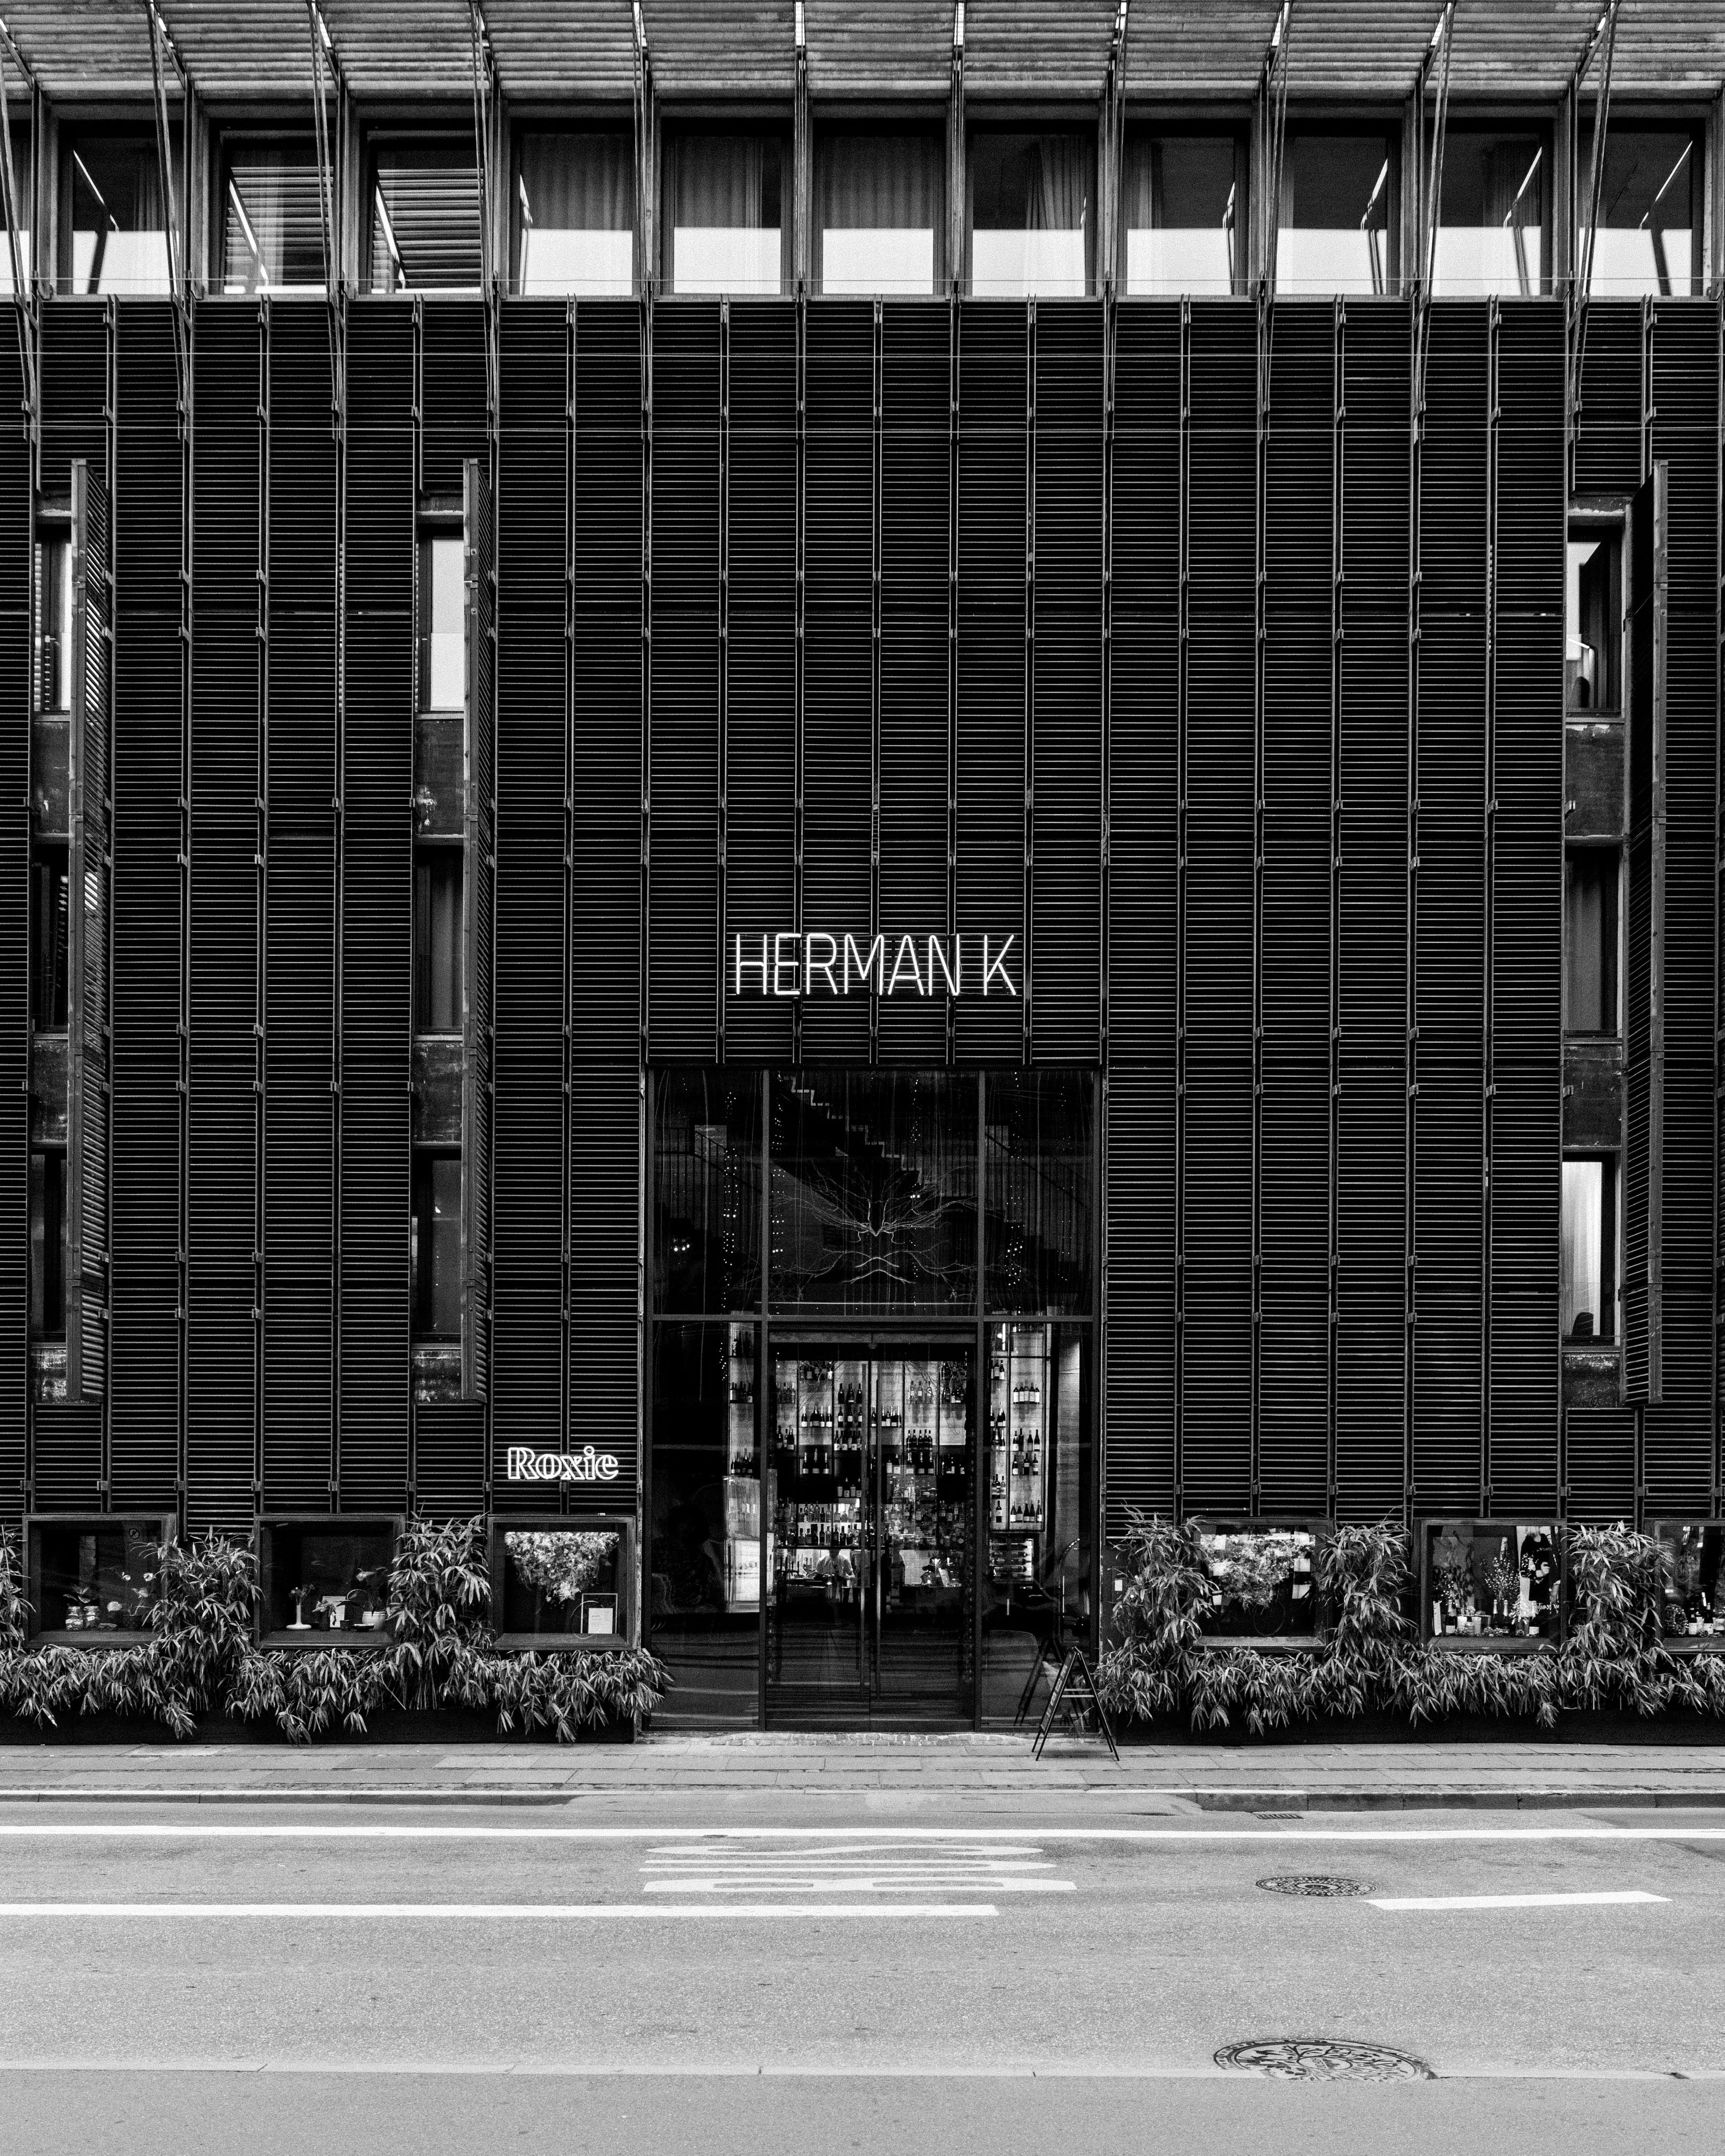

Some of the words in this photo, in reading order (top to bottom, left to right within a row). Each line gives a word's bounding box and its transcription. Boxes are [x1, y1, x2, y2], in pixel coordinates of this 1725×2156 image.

[736, 933, 961, 996] HERMAN
[983, 934, 1017, 996] K
[507, 1446, 619, 1480] Roxie
[638, 1844, 1078, 1892] BUS
